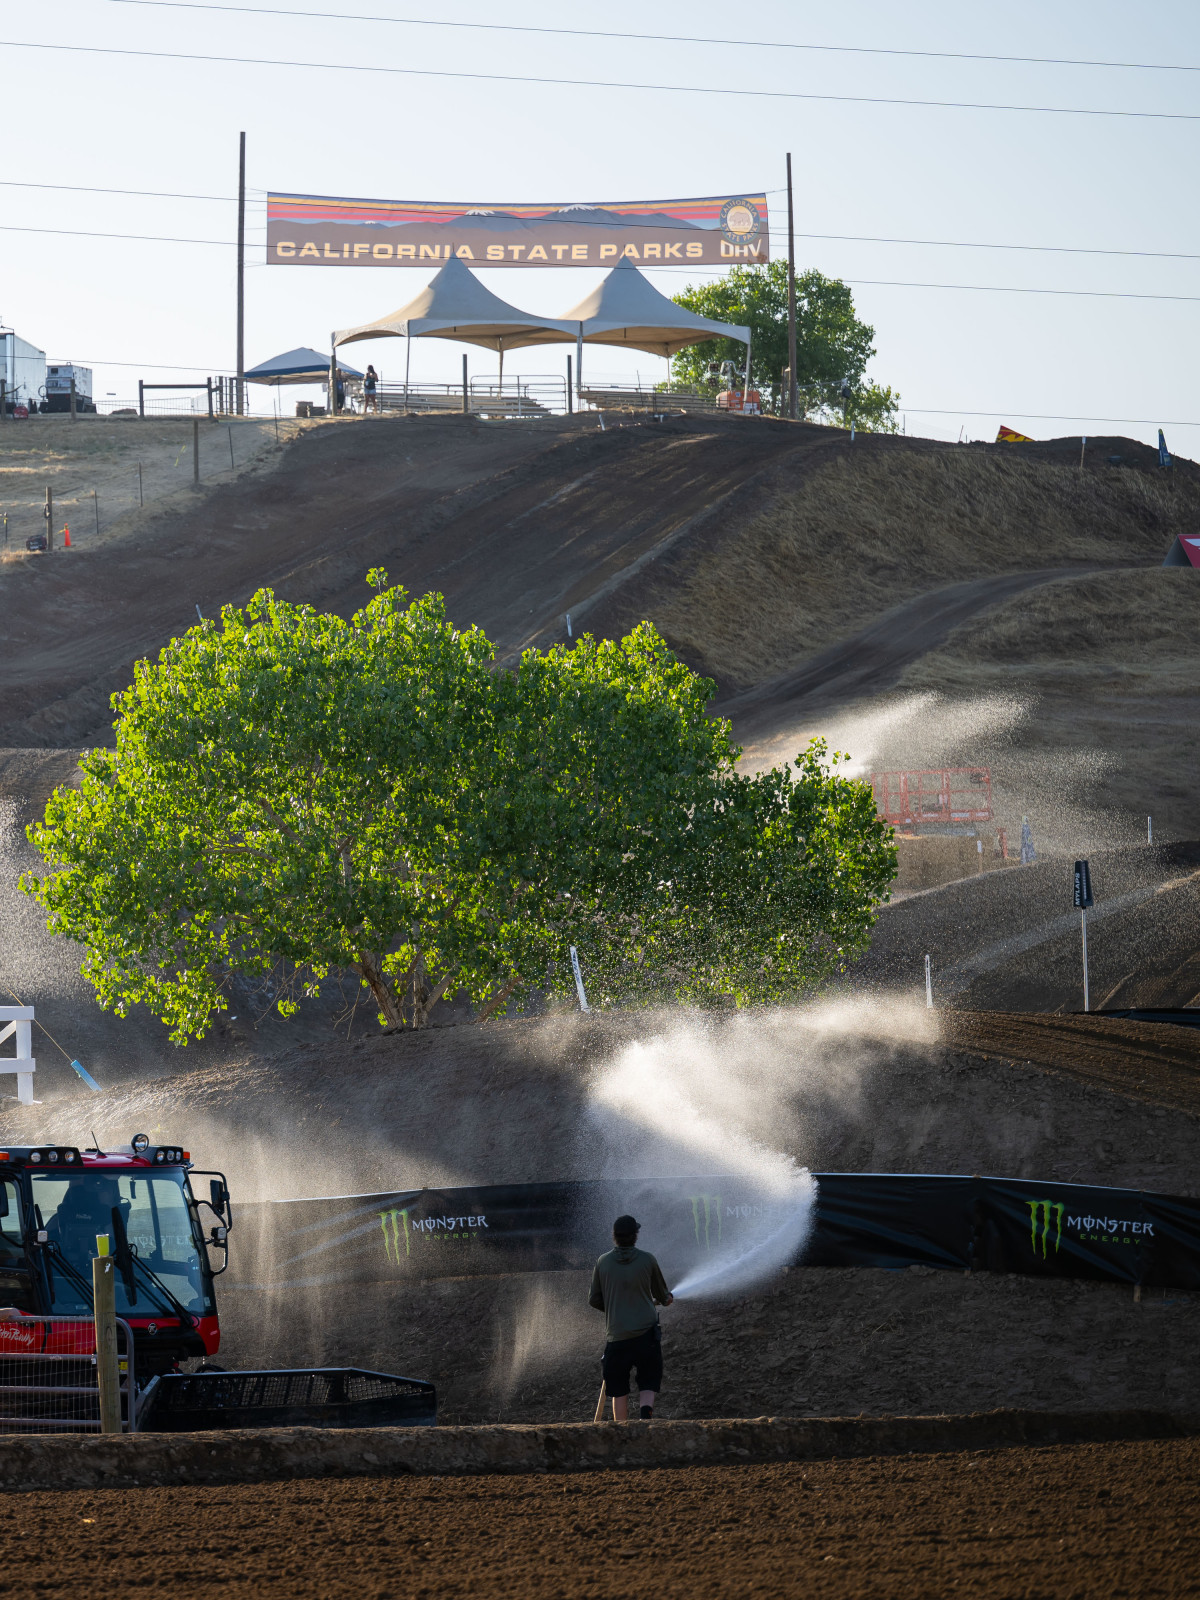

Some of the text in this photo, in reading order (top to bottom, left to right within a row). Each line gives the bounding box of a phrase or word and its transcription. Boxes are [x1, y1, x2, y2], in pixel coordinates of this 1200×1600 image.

[276, 241, 704, 260] CALIFORNIA STATE PARKS
[411, 1215, 489, 1232] MONSTER
[1066, 1214, 1155, 1236] MONSTER
[425, 1232, 478, 1241] ENERGY
[1079, 1233, 1141, 1245] ENERGY
